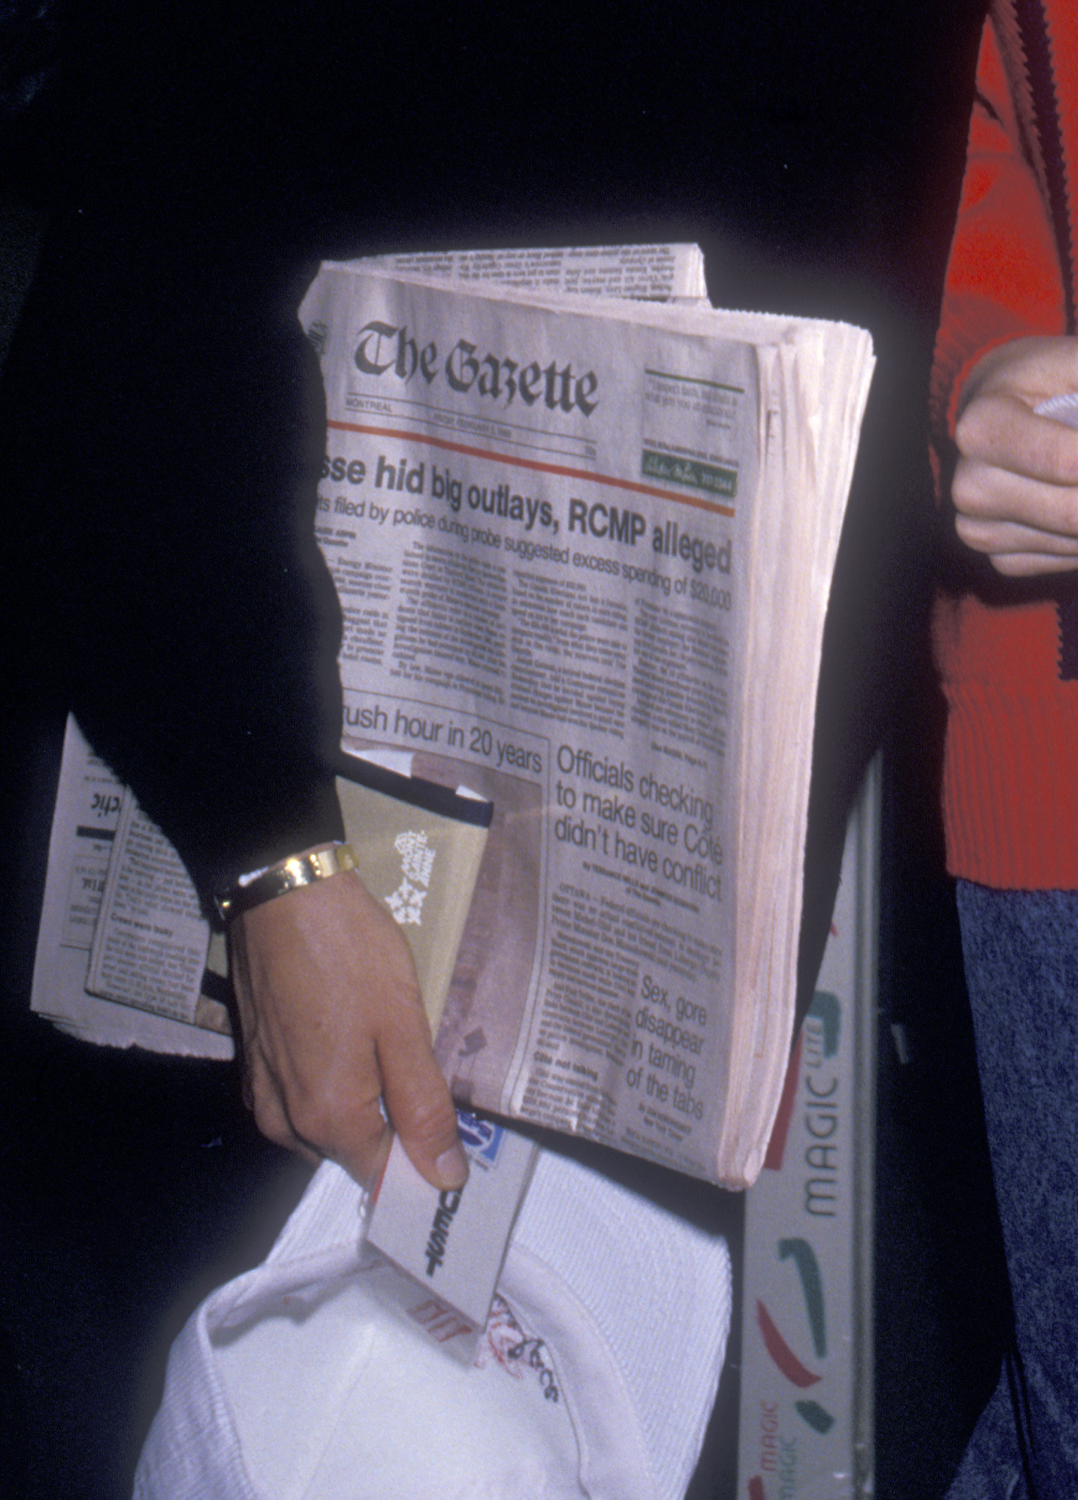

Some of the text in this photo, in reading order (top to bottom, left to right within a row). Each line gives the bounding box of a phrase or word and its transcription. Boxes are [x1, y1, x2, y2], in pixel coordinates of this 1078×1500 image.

[346, 398, 393, 413] MONTREAL
[354, 320, 438, 385] The
[445, 338, 599, 418] Gazette
[334, 495, 365, 517] filed
[369, 503, 389, 525] by
[393, 508, 435, 529] police
[438, 517, 469, 543] during
[471, 526, 501, 548] probe
[504, 536, 570, 564] suggested
[573, 551, 619, 575] excess
[622, 563, 671, 595] spending
[674, 576, 687, 594] of
[374, 455, 424, 494] hid
[431, 465, 463, 512] big
[467, 484, 559, 534] outlays,
[568, 498, 646, 545] RCMP
[652, 520, 732, 575] alleged
[394, 708, 443, 742] hour
[448, 721, 465, 748] in
[469, 726, 493, 756] 20
[496, 740, 543, 773] years
[556, 780, 724, 865] to make sure Côté
[557, 744, 634, 792] Officials
[639, 772, 713, 831] checking
[554, 815, 609, 855] didn't
[614, 831, 658, 873] have
[662, 856, 722, 901] conflict
[636, 1006, 705, 1055] disappear
[642, 975, 707, 1026] Sex, gore
[627, 1067, 643, 1089] of
[648, 1074, 669, 1102] the
[673, 1090, 704, 1120] tabs
[632, 1033, 696, 1089] in taming
[805, 1075, 838, 1217] MAGIC
[425, 1186, 465, 1278] UEST
